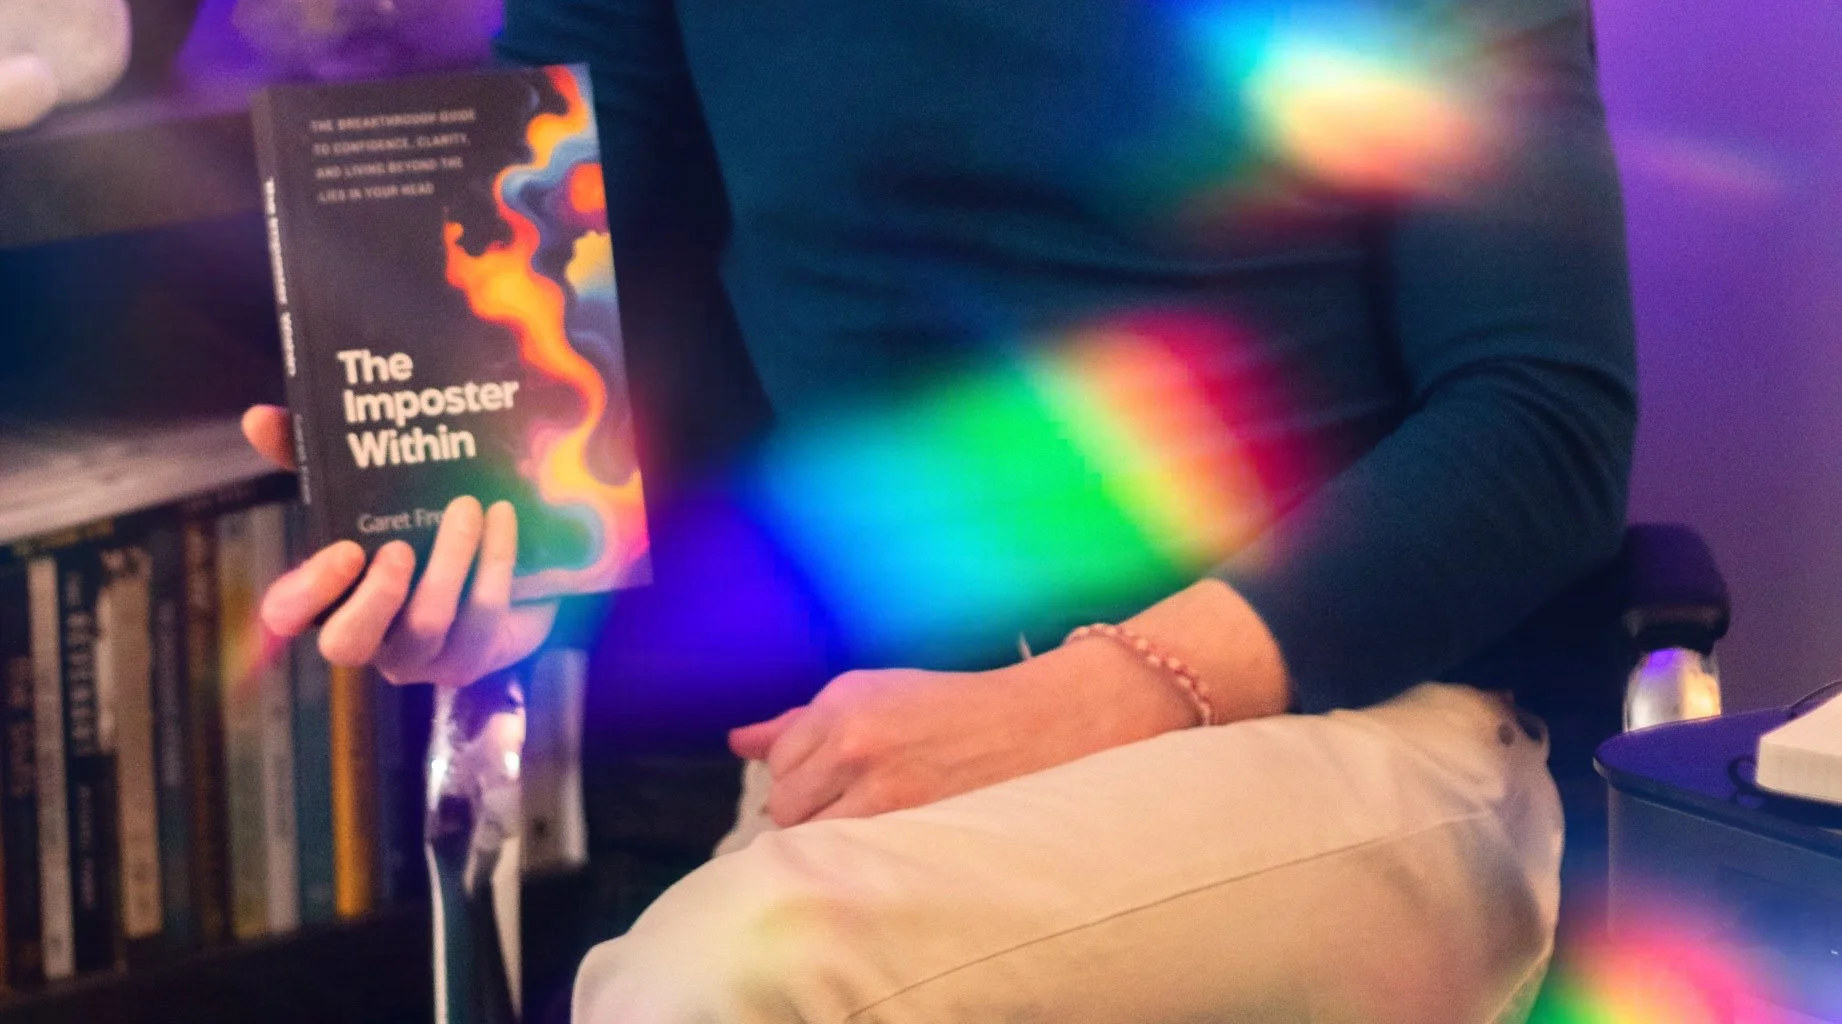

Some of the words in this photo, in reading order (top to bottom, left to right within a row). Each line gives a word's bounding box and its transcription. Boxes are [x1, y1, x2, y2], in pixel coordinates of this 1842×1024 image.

[311, 120, 333, 132] THE
[313, 143, 331, 155] TO
[316, 166, 343, 179] AND
[388, 158, 438, 173] BEYOND
[441, 156, 464, 169] THE
[365, 185, 399, 198] YOUR
[401, 182, 435, 195] HEAD
[337, 349, 414, 384] The
[343, 381, 519, 426] Imposter
[348, 424, 476, 469] Within
[357, 513, 412, 533] Garet
